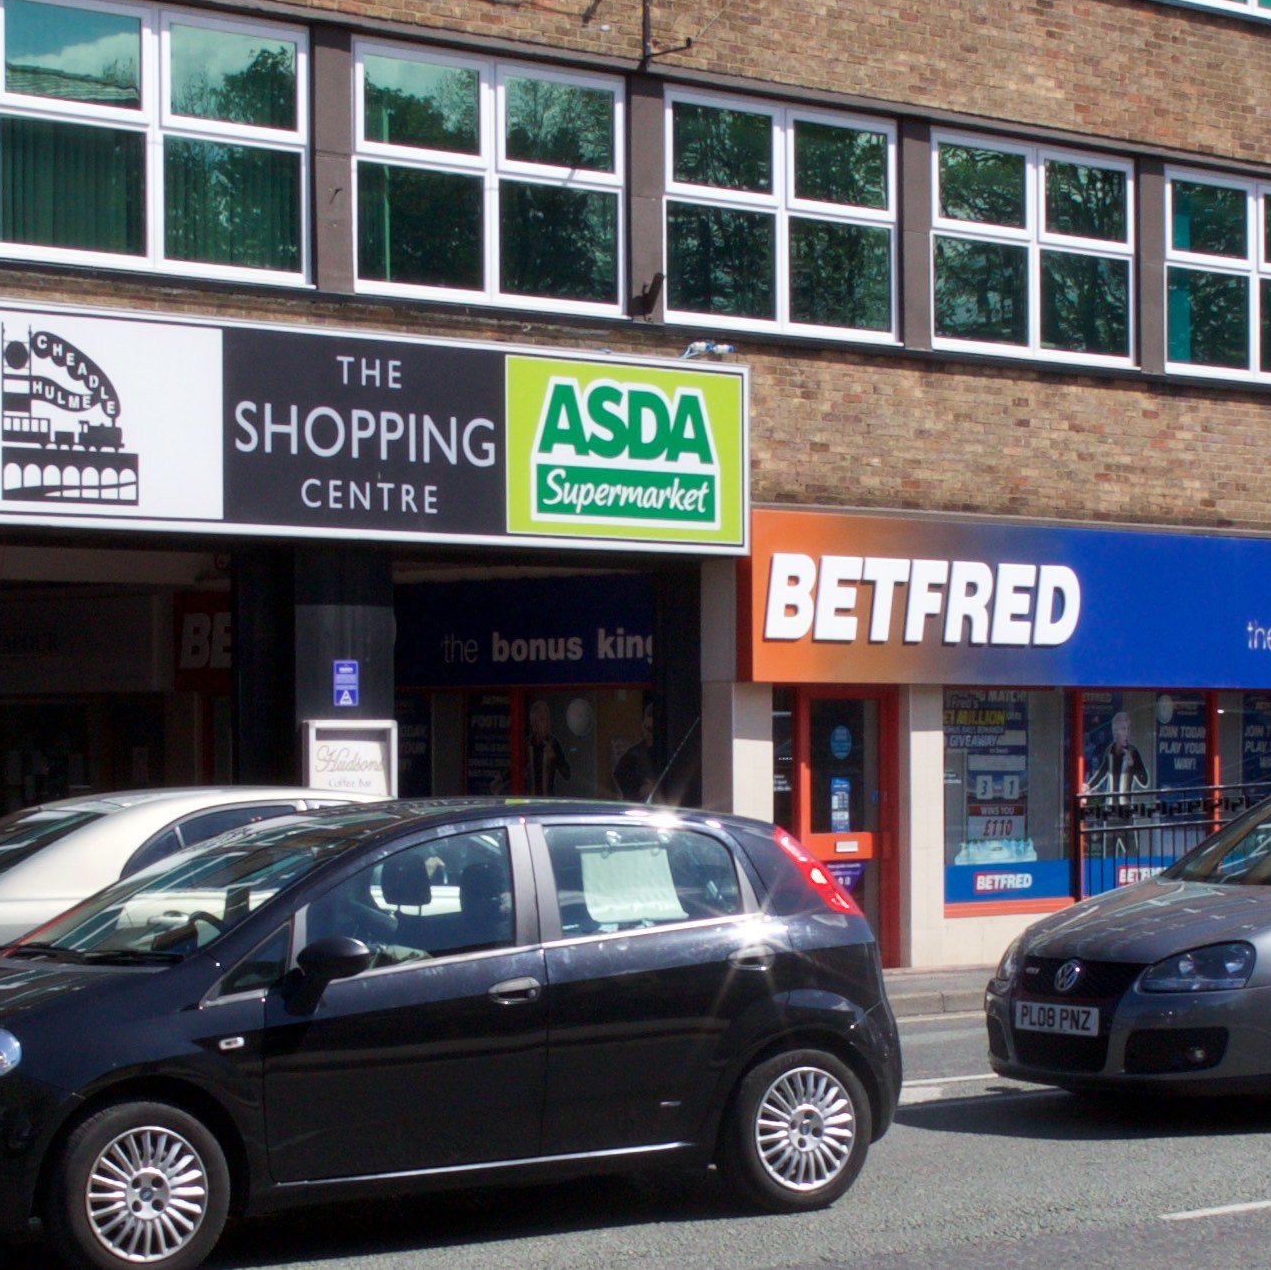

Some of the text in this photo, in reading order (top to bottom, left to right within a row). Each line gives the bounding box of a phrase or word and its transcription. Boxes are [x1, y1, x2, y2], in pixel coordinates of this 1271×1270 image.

[37, 335, 116, 415] CHEADLE
[336, 355, 402, 389] THE
[32, 381, 91, 409] HULME
[234, 401, 496, 467] SHOPPING
[537, 382, 714, 465] ASDA
[301, 478, 438, 514] CENTRE
[543, 468, 709, 515] Supermarket
[764, 553, 1081, 646] BETFRED
[442, 634, 479, 664] the
[492, 631, 583, 663] bonus
[956, 709, 1005, 726] MILLION
[1159, 726, 1179, 738] JOIN
[1159, 741, 1182, 754] PLAY
[1174, 757, 1197, 771] WAY!
[980, 805, 1015, 816] WINS YOU
[982, 819, 1013, 838] £110
[976, 872, 1033, 891] BETFRED
[1020, 1004, 1091, 1032] PL08 PNZ
